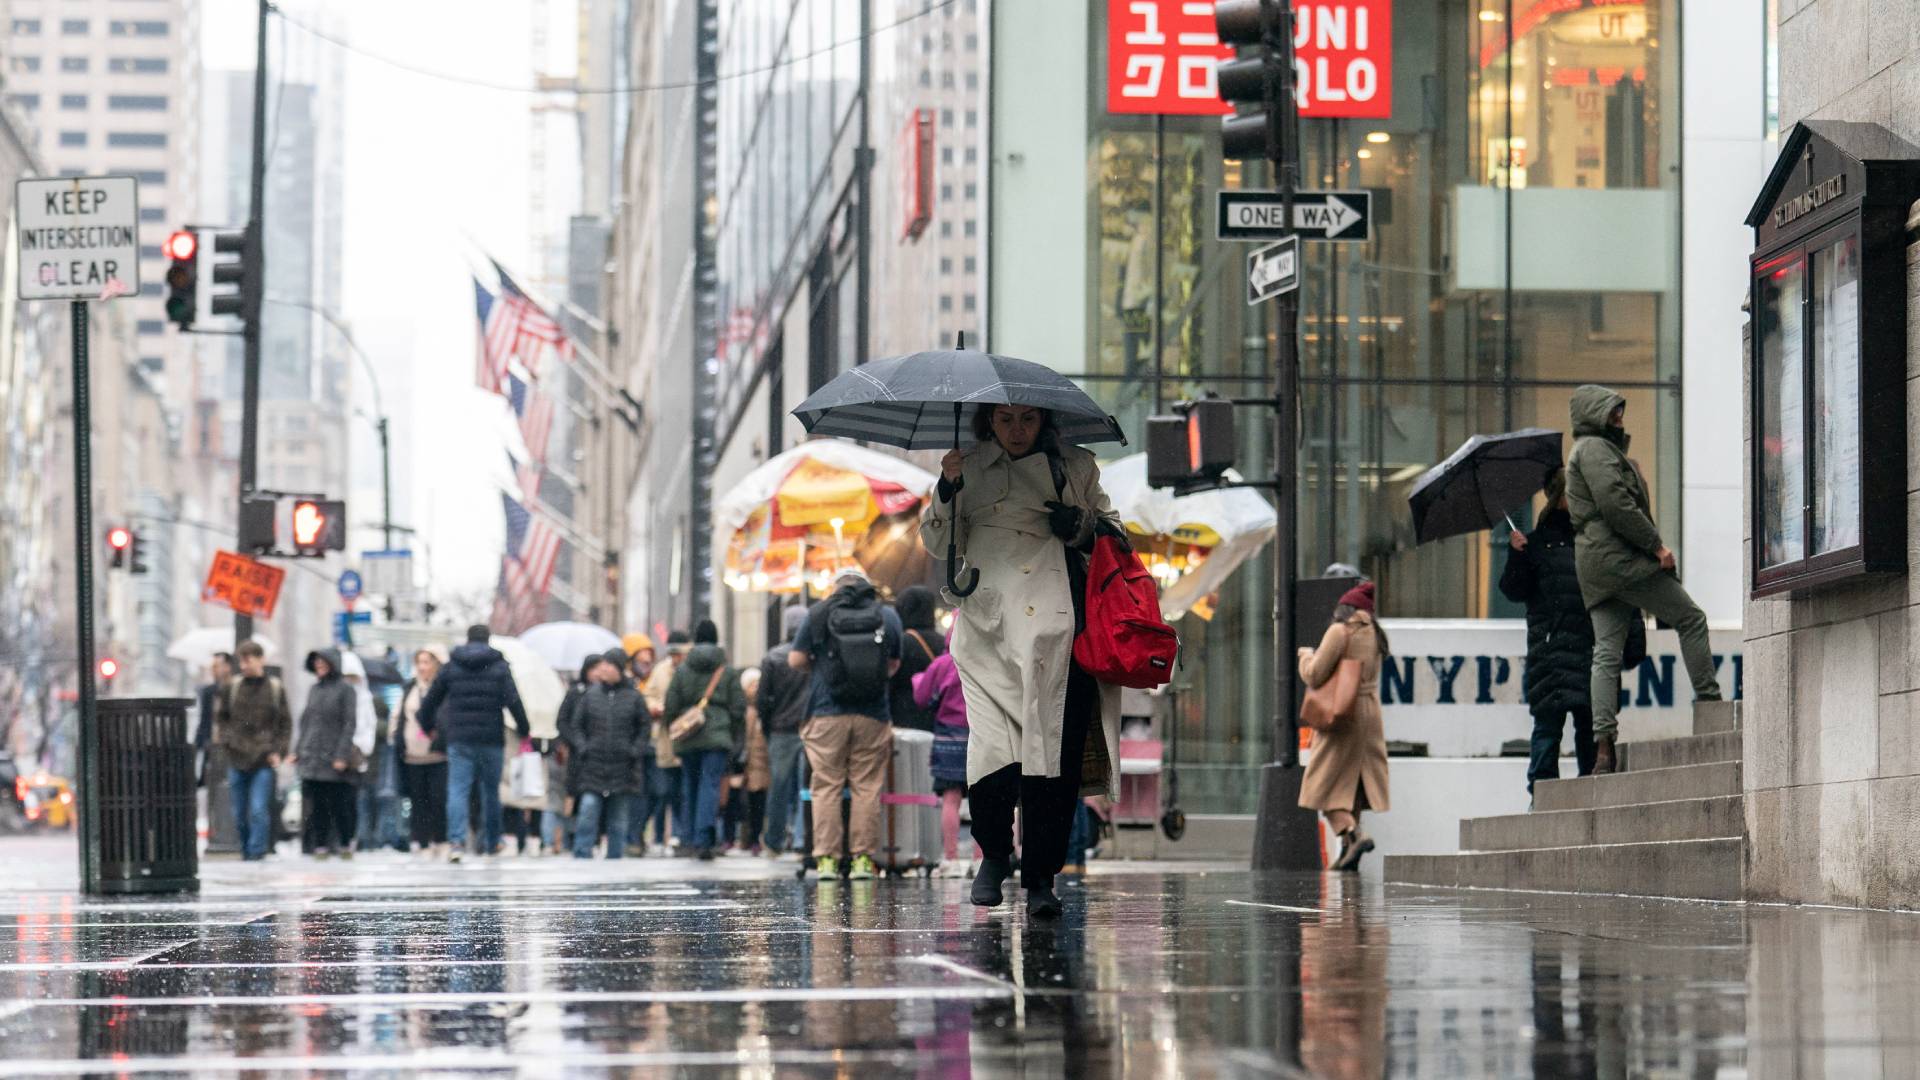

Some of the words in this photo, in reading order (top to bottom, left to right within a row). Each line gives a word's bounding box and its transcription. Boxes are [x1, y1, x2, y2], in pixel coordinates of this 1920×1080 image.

[1600, 14, 1626, 38] UT
[46, 189, 107, 215] KEEP
[1813, 174, 1842, 208] CHURCH
[1240, 206, 1281, 226] ONE
[1303, 207, 1346, 226] WAY
[21, 226, 132, 250] INTERSECTION
[38, 260, 118, 287] CLEAR
[1381, 655, 1528, 705] NYP
